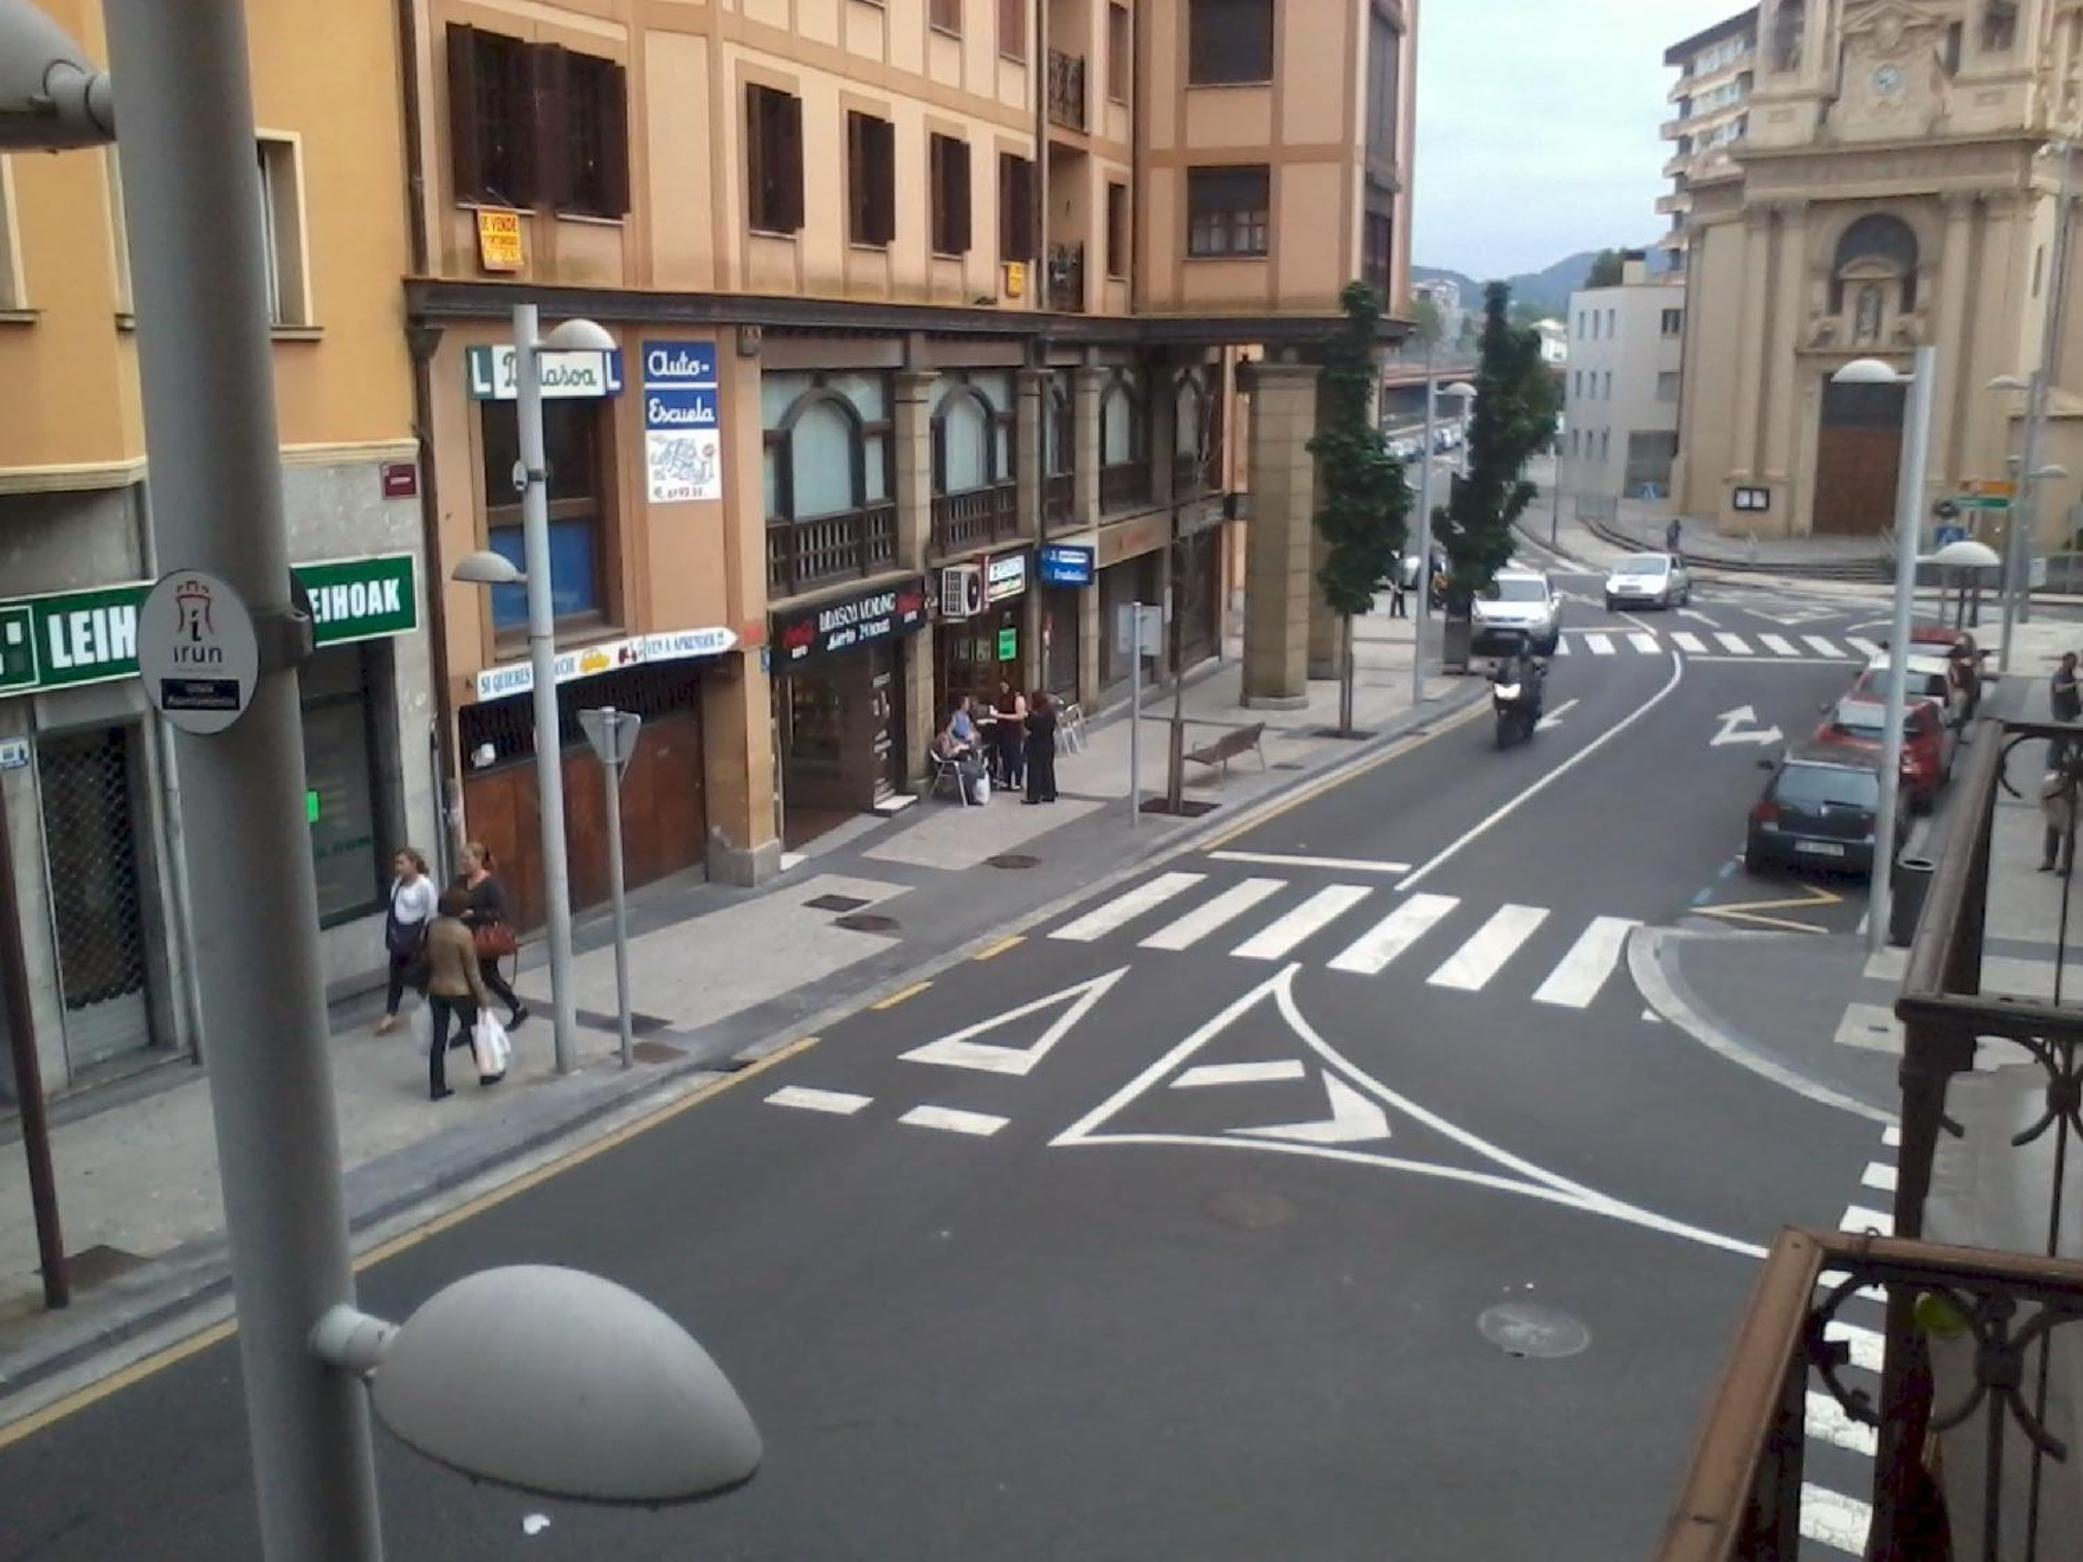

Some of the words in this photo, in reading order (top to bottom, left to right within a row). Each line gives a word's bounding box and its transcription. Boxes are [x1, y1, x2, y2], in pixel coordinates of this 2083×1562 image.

[649, 396, 715, 424] Escuela
[307, 577, 401, 624] EIHOAK
[47, 605, 136, 669] LEIH
